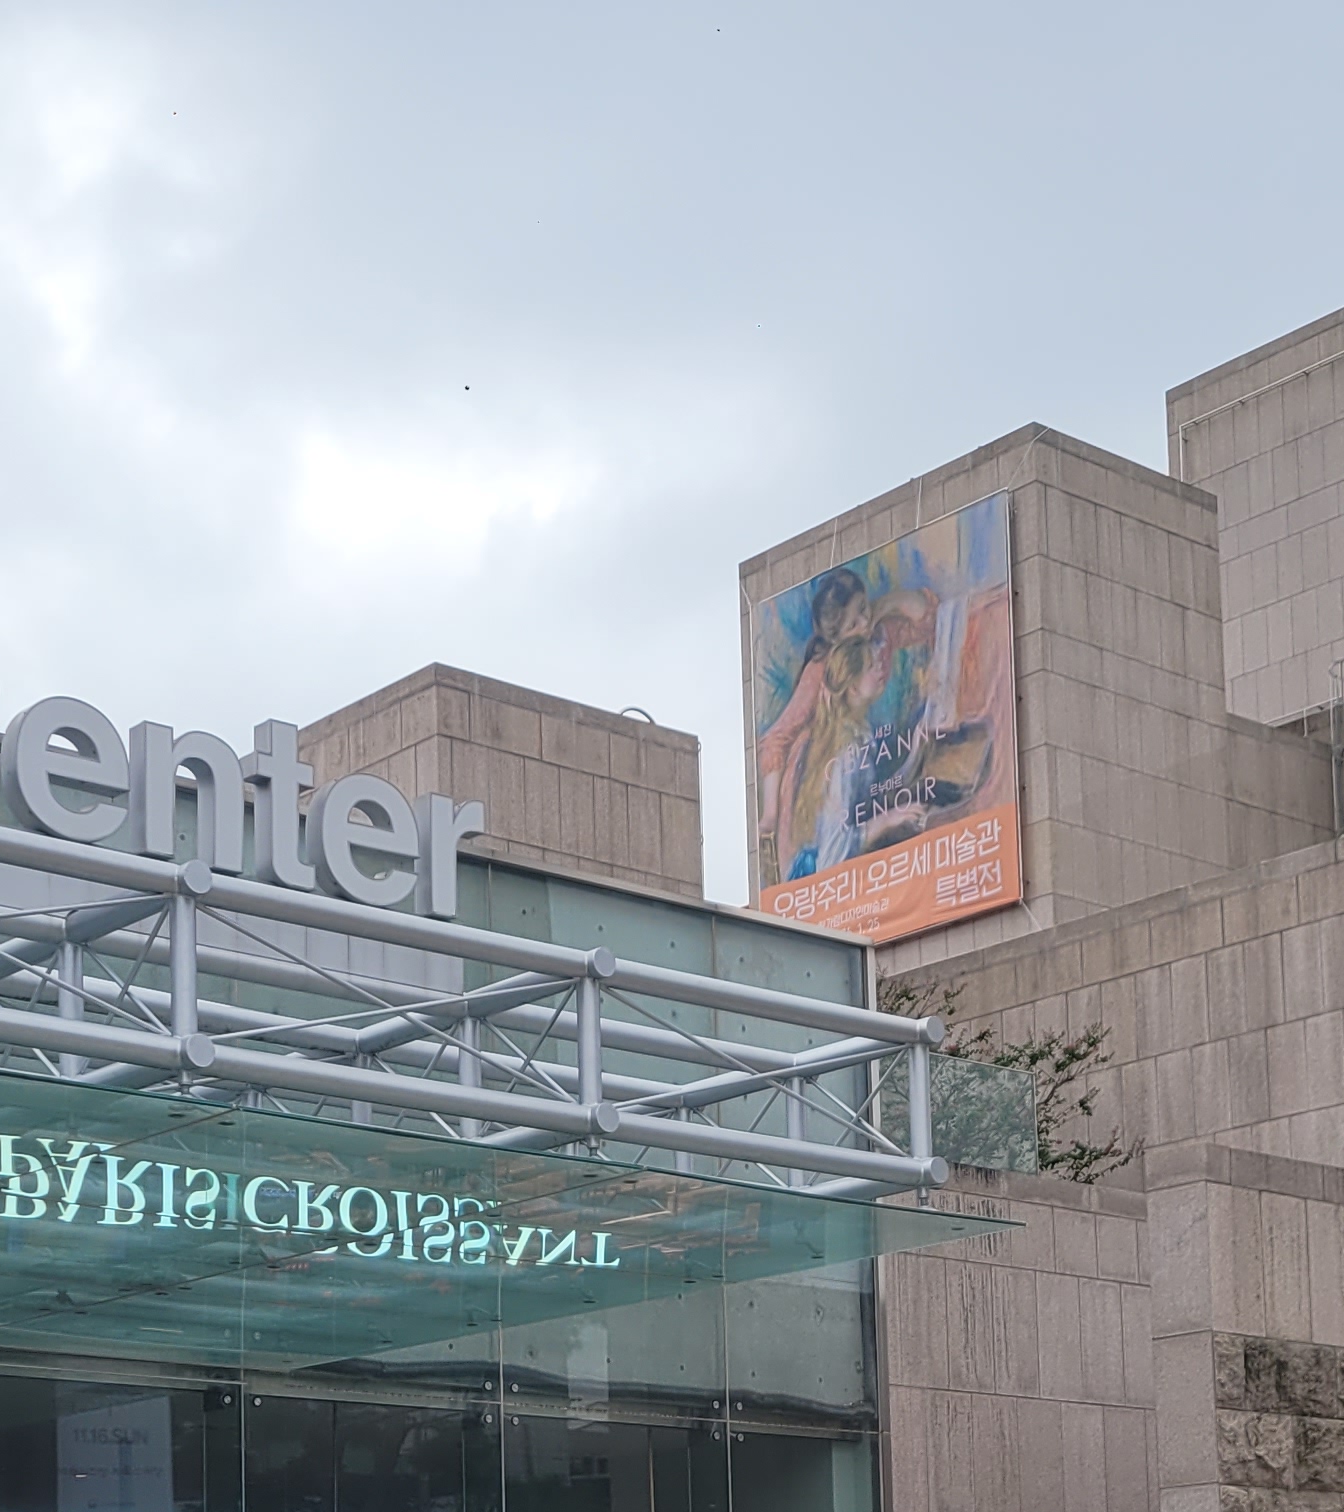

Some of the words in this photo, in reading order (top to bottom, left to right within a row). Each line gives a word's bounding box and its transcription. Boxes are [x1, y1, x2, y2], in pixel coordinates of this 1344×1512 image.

[839, 776, 936, 831] RENOIR
[774, 869, 856, 920] 오랑주리
[935, 859, 1003, 906] 특별전
